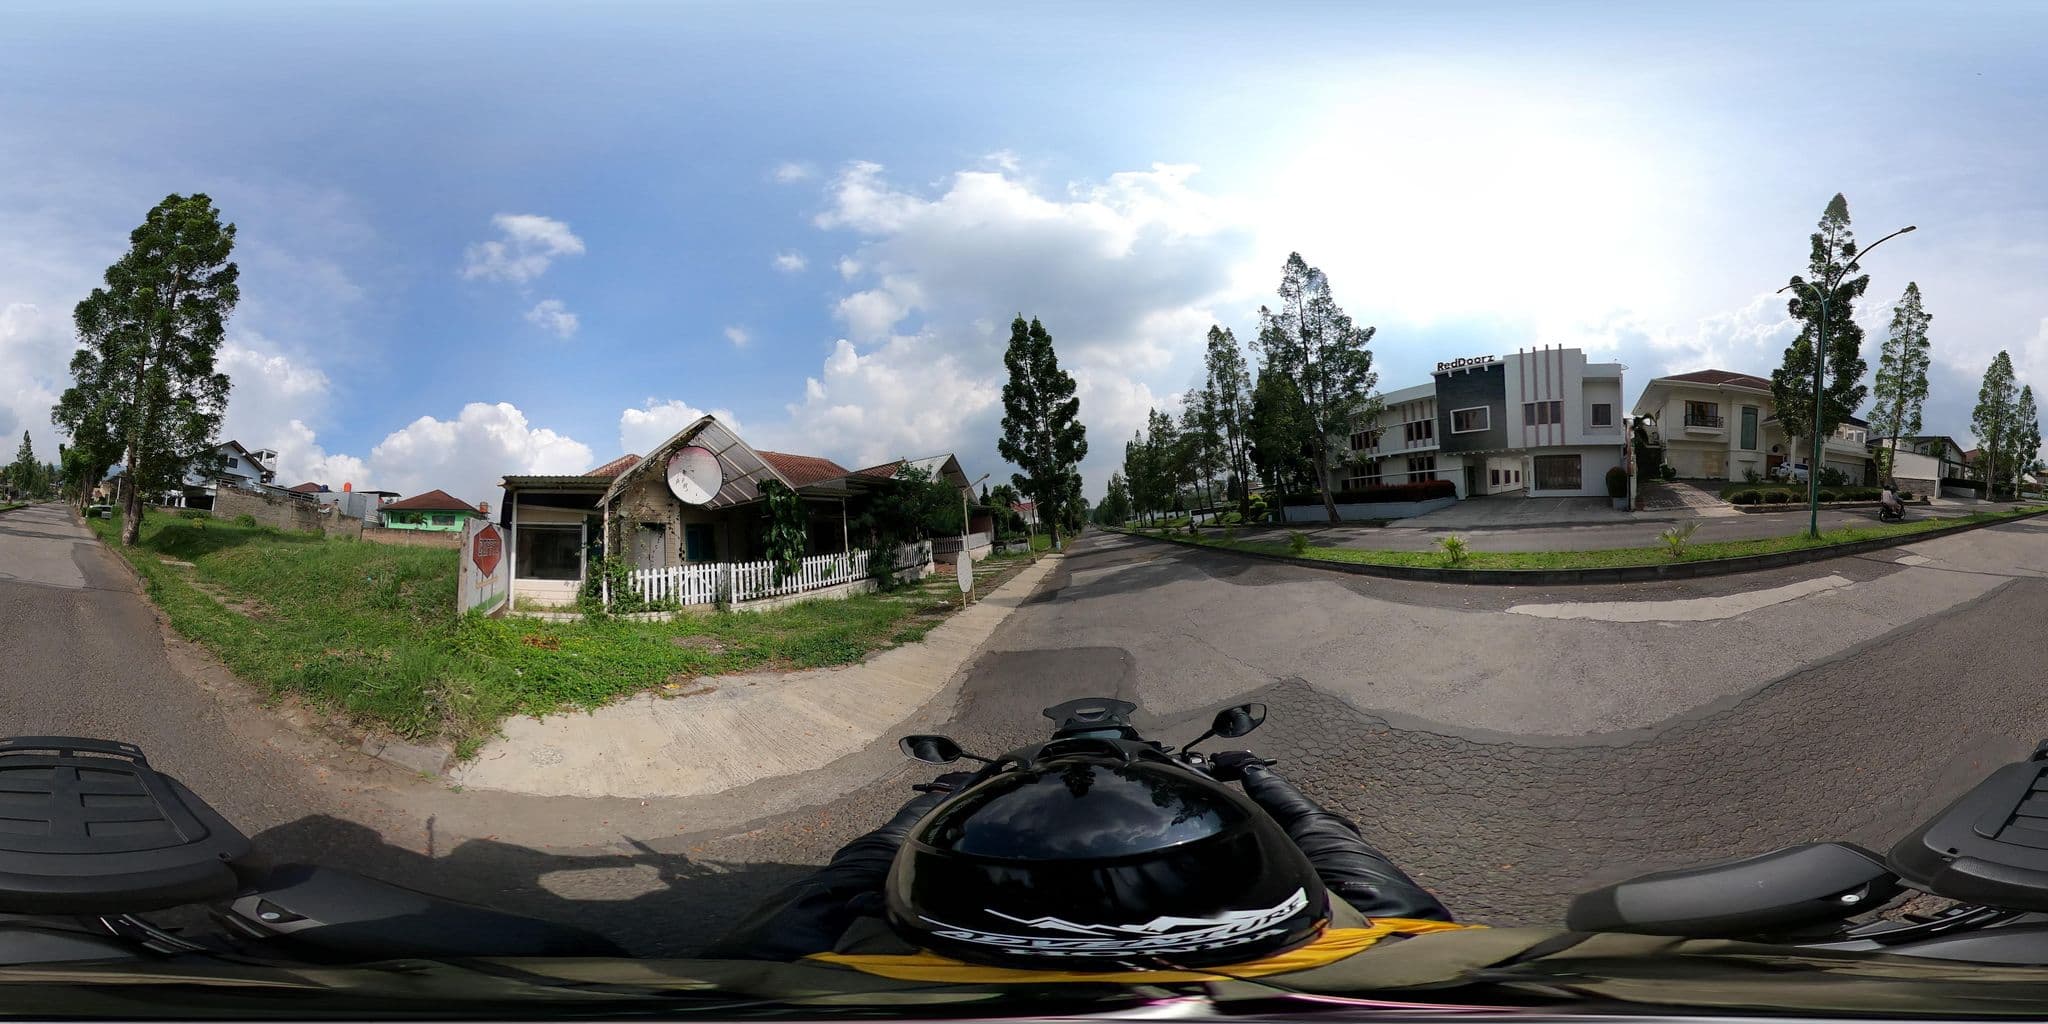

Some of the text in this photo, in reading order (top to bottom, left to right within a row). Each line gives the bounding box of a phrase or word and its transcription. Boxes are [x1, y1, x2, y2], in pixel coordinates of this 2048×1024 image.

[1437, 355, 1494, 371] RedDoorz
[931, 893, 1308, 949] ADVENTURE
[1004, 929, 1288, 957] HONDA
